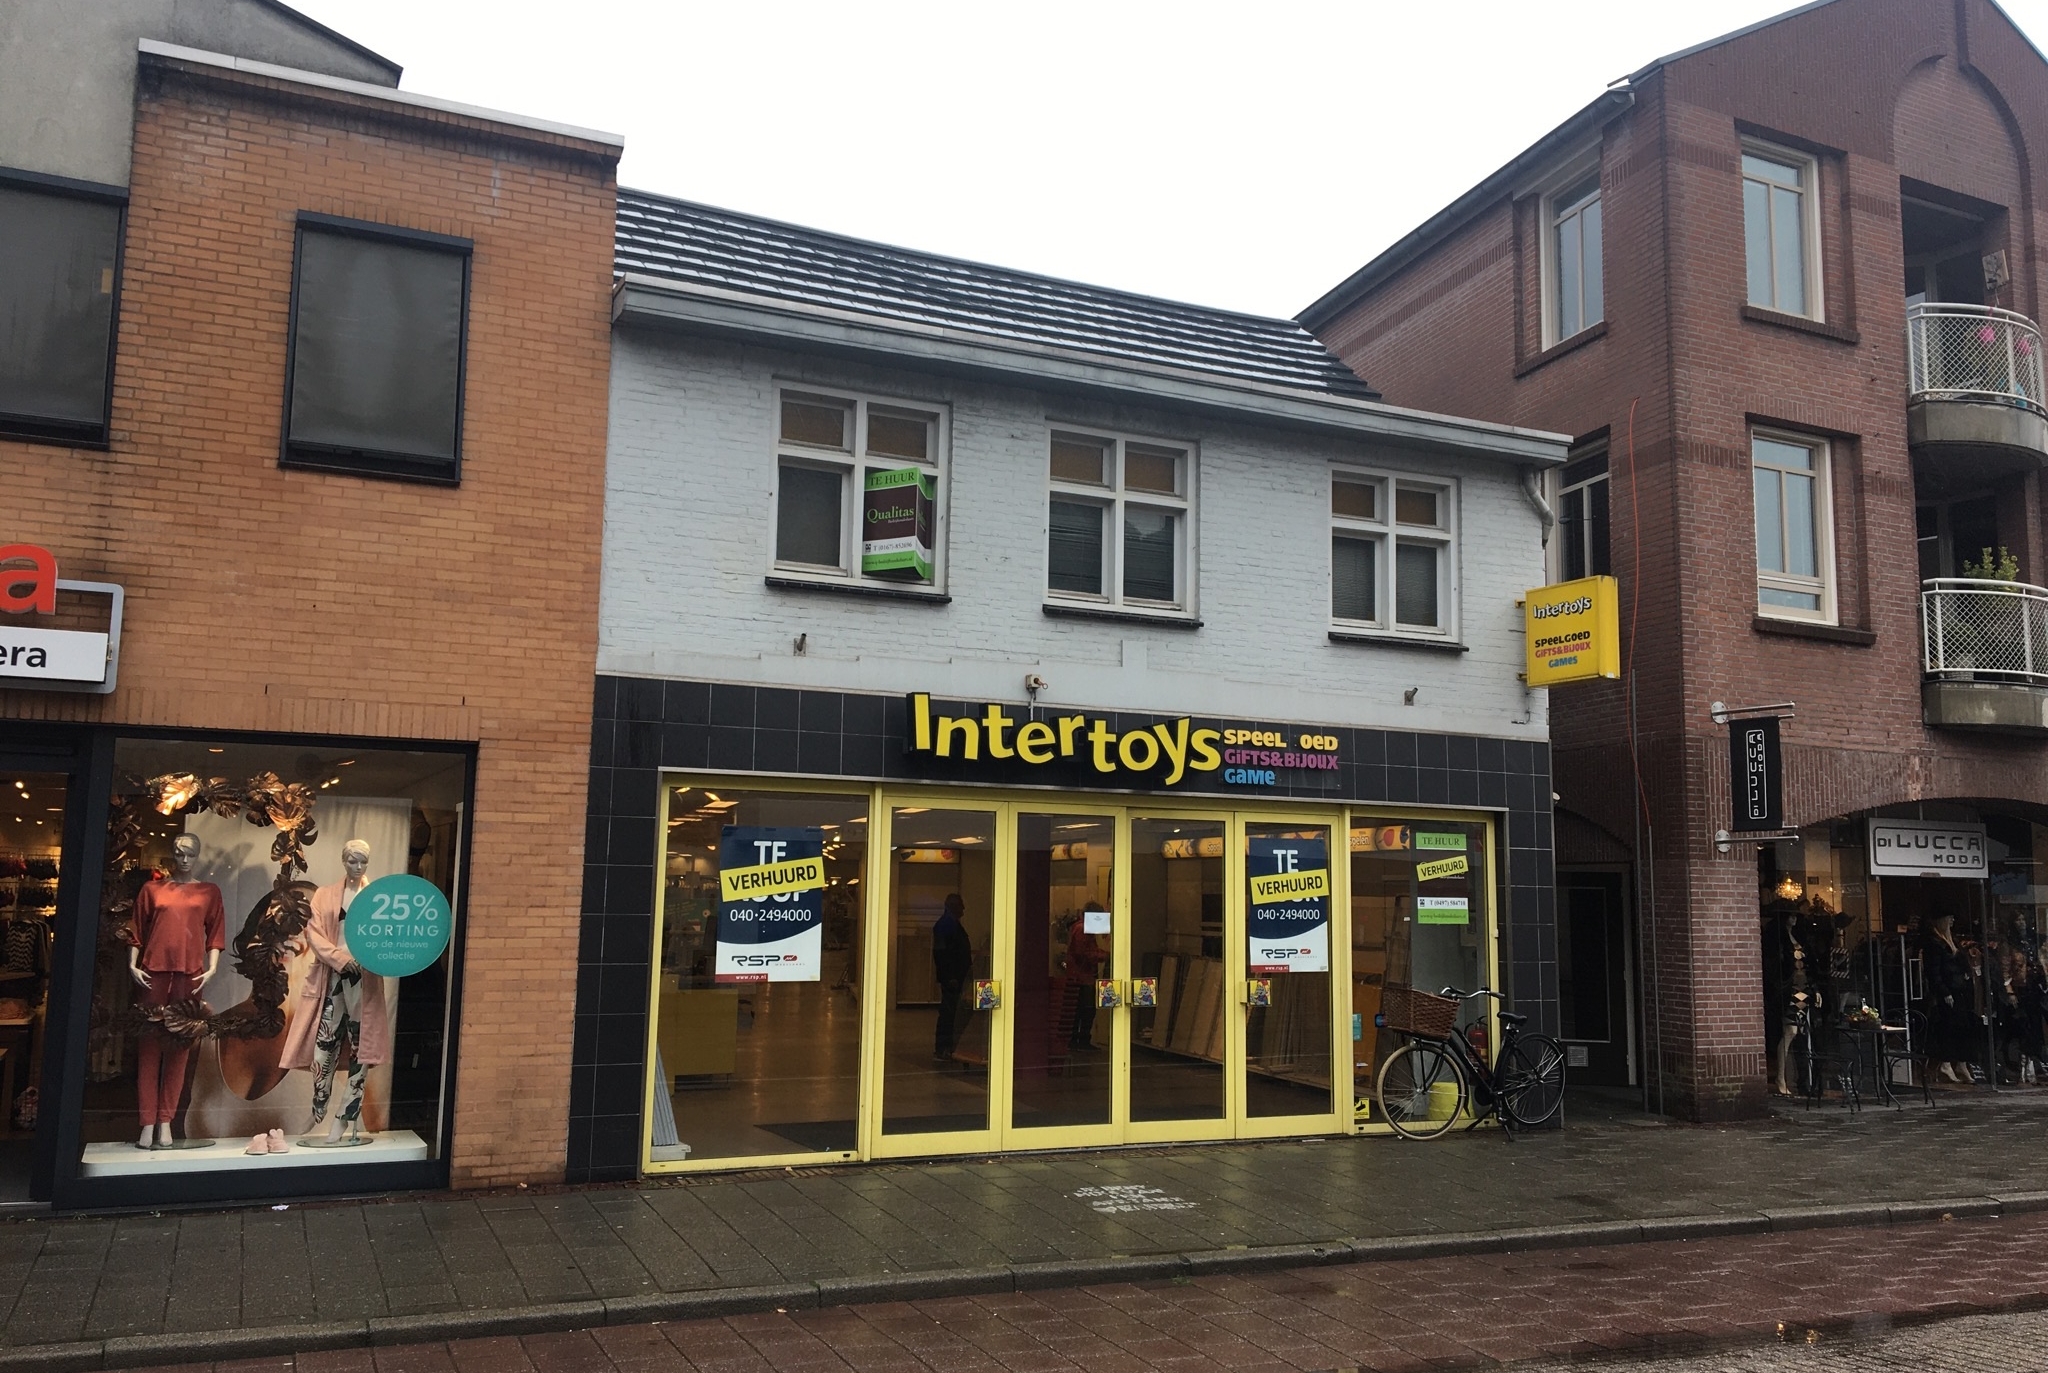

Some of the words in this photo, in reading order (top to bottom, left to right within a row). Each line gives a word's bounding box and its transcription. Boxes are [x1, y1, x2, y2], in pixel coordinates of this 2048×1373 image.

[870, 476, 883, 487] TE
[885, 471, 915, 485] HUUR
[866, 505, 915, 524] Qualitas
[1533, 596, 1592, 619] Intertoys
[912, 692, 1223, 786] Intertoys
[1748, 733, 1759, 801] LUCCA
[1421, 836, 1434, 845] TE
[1435, 837, 1460, 846] HUUR
[1877, 837, 1892, 847] DI
[1896, 833, 1981, 851] LUCCA
[1272, 849, 1299, 873] TE
[1933, 853, 1981, 864] MODA
[1420, 860, 1465, 877] VERHUURD
[728, 864, 818, 891] VERHUURD
[1256, 875, 1323, 896] VERHUURD
[371, 893, 439, 921] 25%
[357, 924, 440, 937] KORTING
[365, 940, 379, 949] op
[381, 940, 394, 948] de
[396, 940, 429, 949] nieuwe
[377, 951, 416, 961] collectie
[731, 955, 781, 967] RSP
[1261, 948, 1299, 959] RSP
[735, 973, 767, 981] www.rsp.nl
